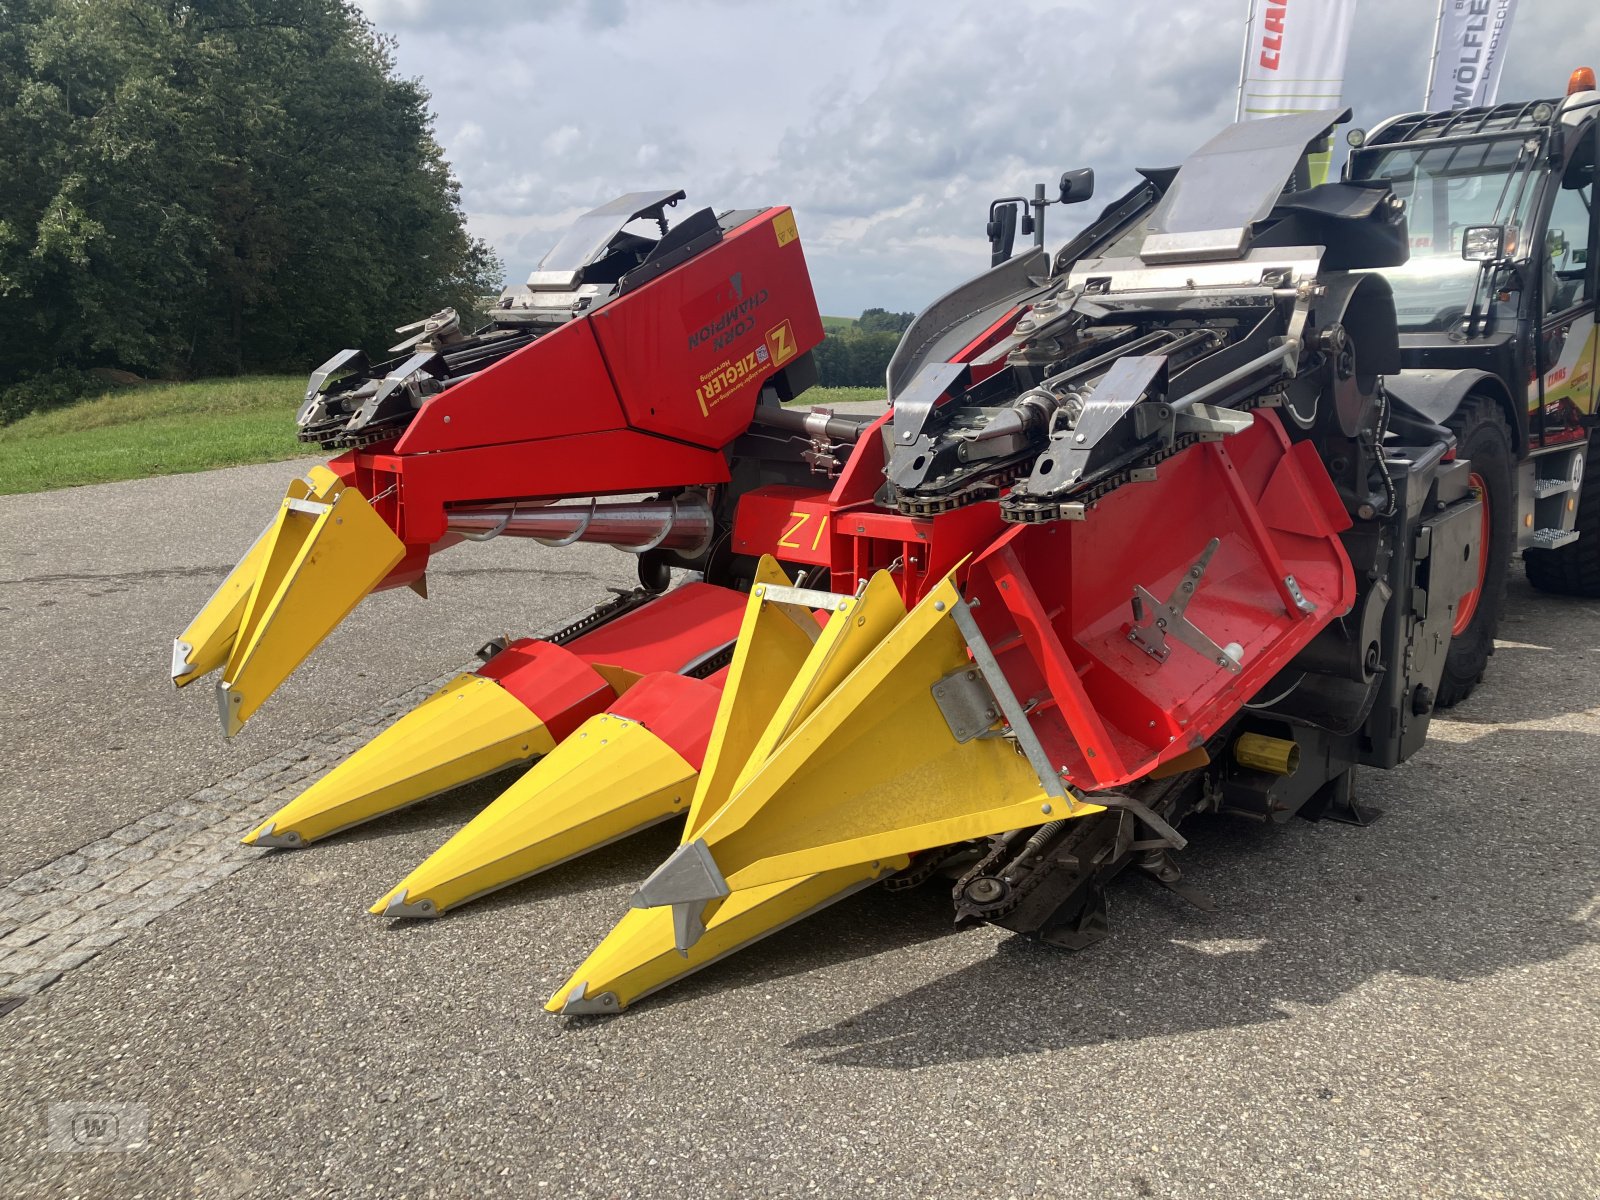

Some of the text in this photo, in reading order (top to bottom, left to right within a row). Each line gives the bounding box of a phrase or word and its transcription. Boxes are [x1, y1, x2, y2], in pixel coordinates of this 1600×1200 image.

[1260, 0, 1287, 70] CLA
[688, 288, 769, 352] CHAMPION
[713, 315, 756, 353] CORN
[771, 325, 791, 360] Z
[700, 360, 731, 382] Harvesting
[703, 351, 758, 399] ZIEGLER
